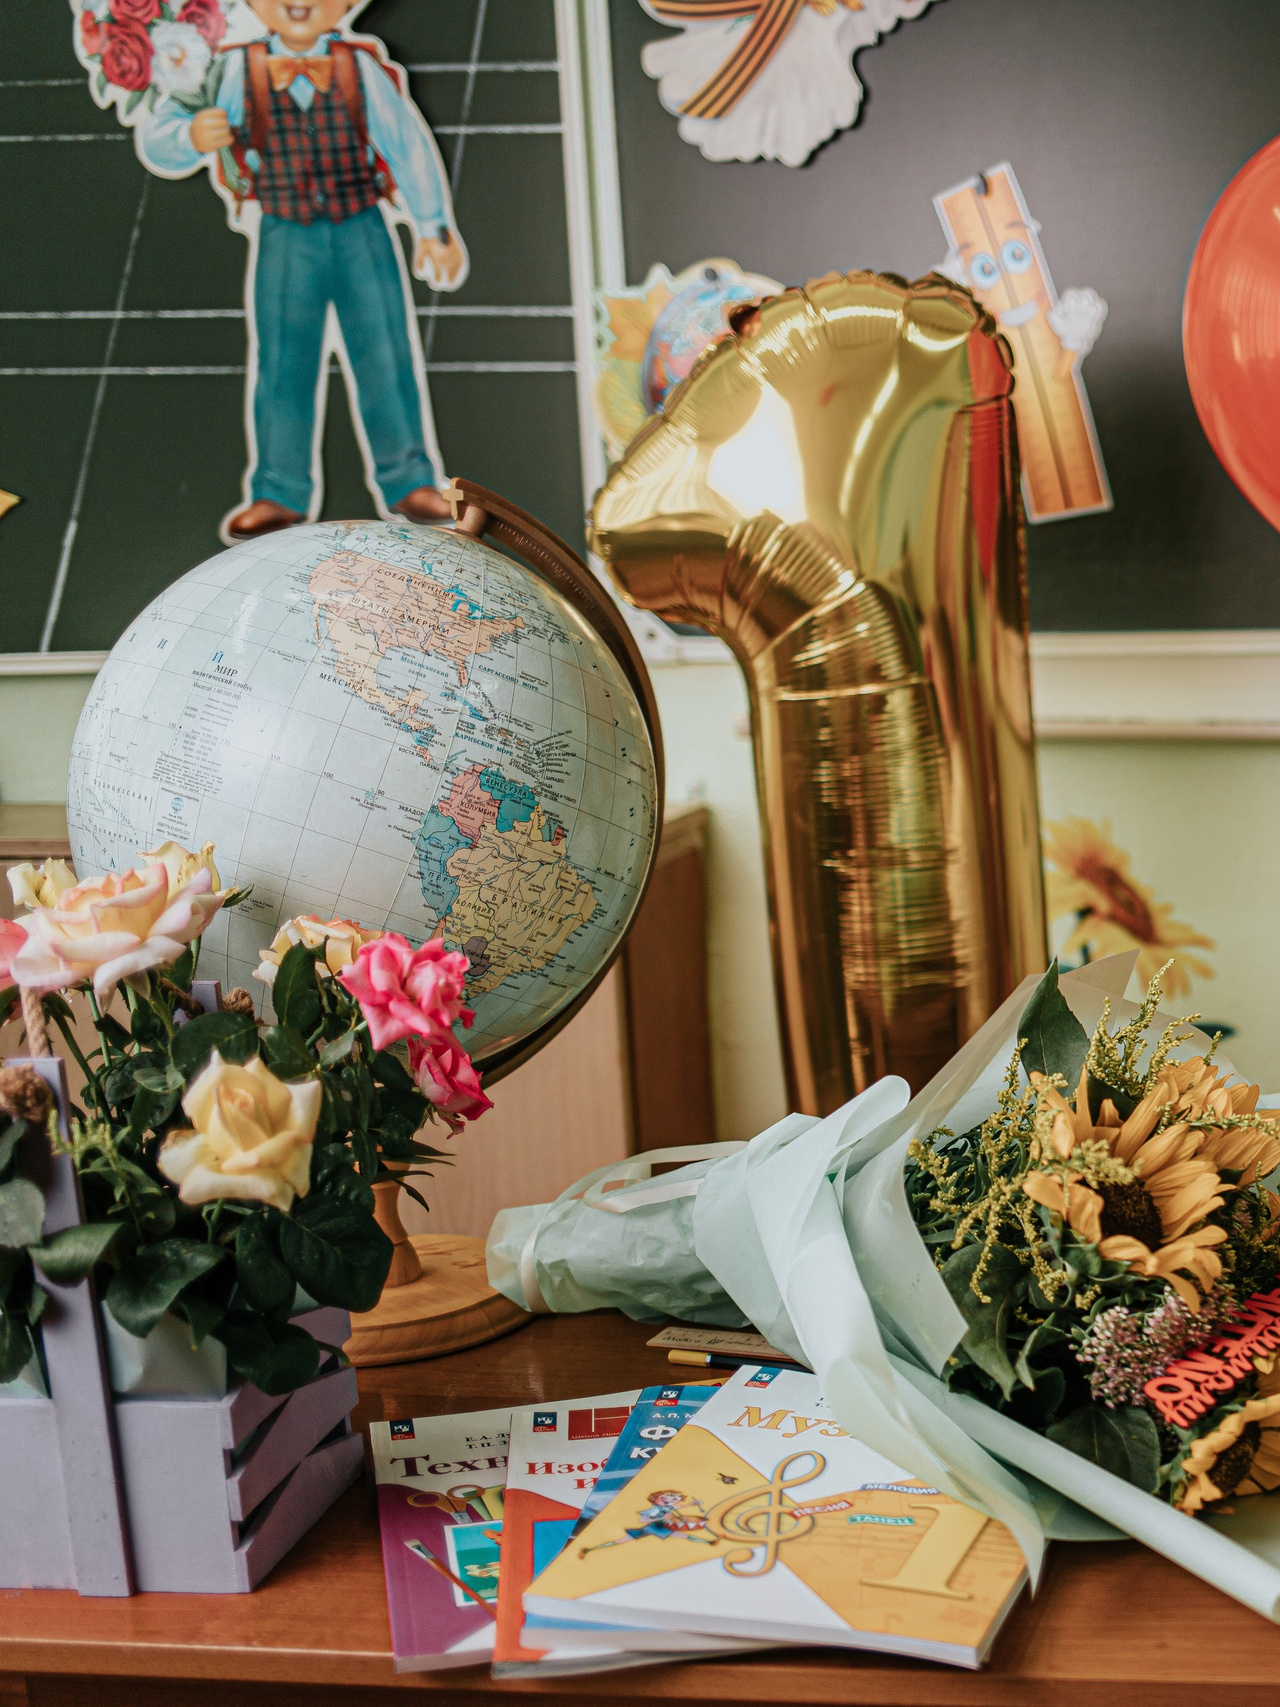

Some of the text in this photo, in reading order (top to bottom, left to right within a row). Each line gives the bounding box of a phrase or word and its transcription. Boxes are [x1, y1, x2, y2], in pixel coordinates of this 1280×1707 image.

[377, 568, 457, 600] СОЕДИНЕННЫЕ
[351, 597, 391, 614] ШТАТЫ
[399, 613, 450, 634] АМЕРИКИ
[214, 664, 238, 677] МИР
[400, 655, 450, 678] Мексиканский
[408, 669, 427, 679] залив
[192, 670, 254, 692] политический глобус
[318, 672, 364, 693] МЕКСИКА
[478, 664, 540, 692] САРГАССОВО МОРЕ
[192, 682, 213, 692] Масштаб
[398, 747, 416, 756] КОСТА
[454, 732, 494, 750] КАРИБСКОЕ
[495, 746, 514, 757] МОРЕ
[270, 754, 281, 763] 110
[419, 761, 440, 772] ПАНАМА
[322, 771, 334, 780] 100
[485, 776, 528, 797] ВЕНЕСУЭЛА
[398, 804, 424, 817] ЭКВАДОР
[460, 801, 496, 818] КОЛУМБИЯ
[428, 871, 455, 885] ПЕРУ
[455, 898, 491, 914] БОЛИВИЯ
[491, 893, 563, 924] БРАЗИЛИЯ
[866, 1484, 938, 1495] МЕЛОДИЯ
[793, 1500, 851, 1518] ПЕСНЯ
[854, 1514, 912, 1526] ТАНЕЦ
[858, 1503, 990, 1601] 1
